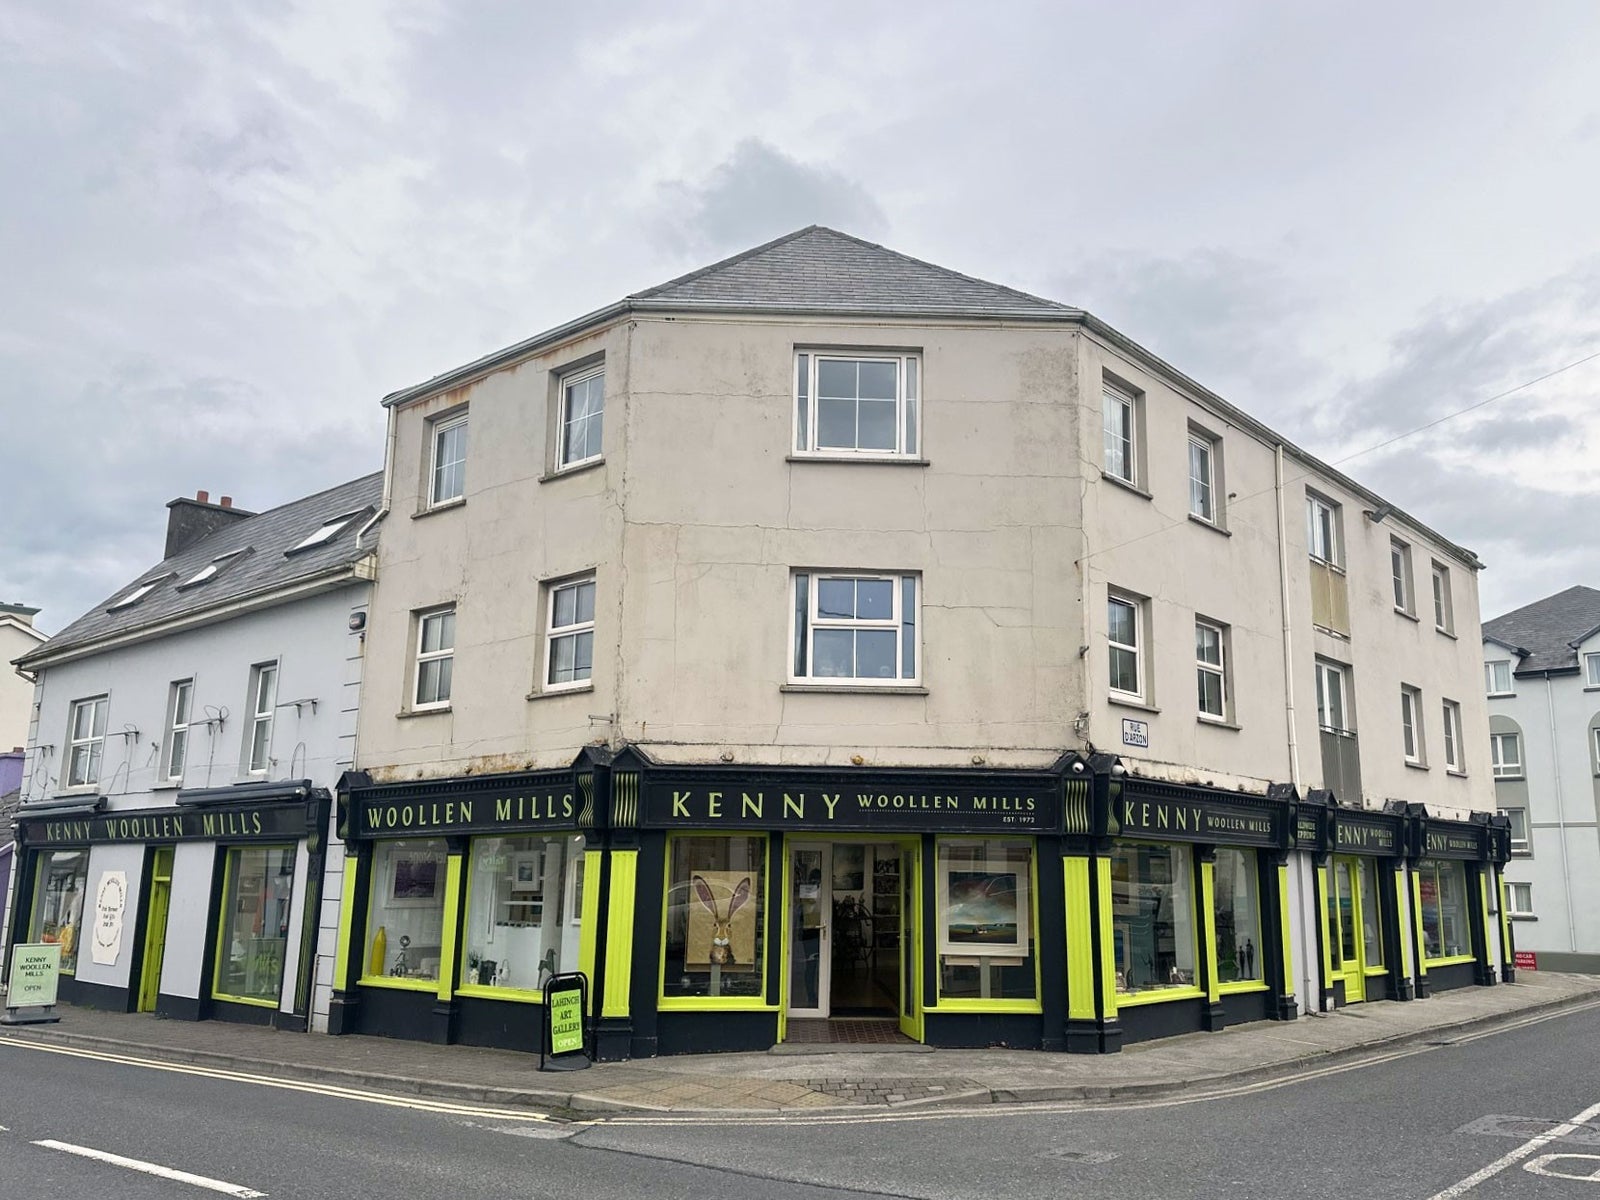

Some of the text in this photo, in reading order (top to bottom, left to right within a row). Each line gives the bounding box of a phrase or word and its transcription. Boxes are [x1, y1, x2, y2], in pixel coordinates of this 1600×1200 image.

[1129, 722, 1141, 733] RUE
[368, 794, 573, 828] WOOLLEN MILLS
[671, 791, 1035, 820] KENNY WOOLLEN MILLS
[1125, 801, 1271, 832] KENNY WOOLLEN MILLS
[46, 812, 262, 841] KENNY WOOLLEN MILLS
[1338, 824, 1368, 846] ENNY
[1426, 833, 1448, 850] ENNY
[552, 996, 580, 1008] LAHINCH
[560, 1010, 572, 1020] ART
[553, 1022, 580, 1035] GALLERY
[558, 1038, 577, 1047] OPEN
